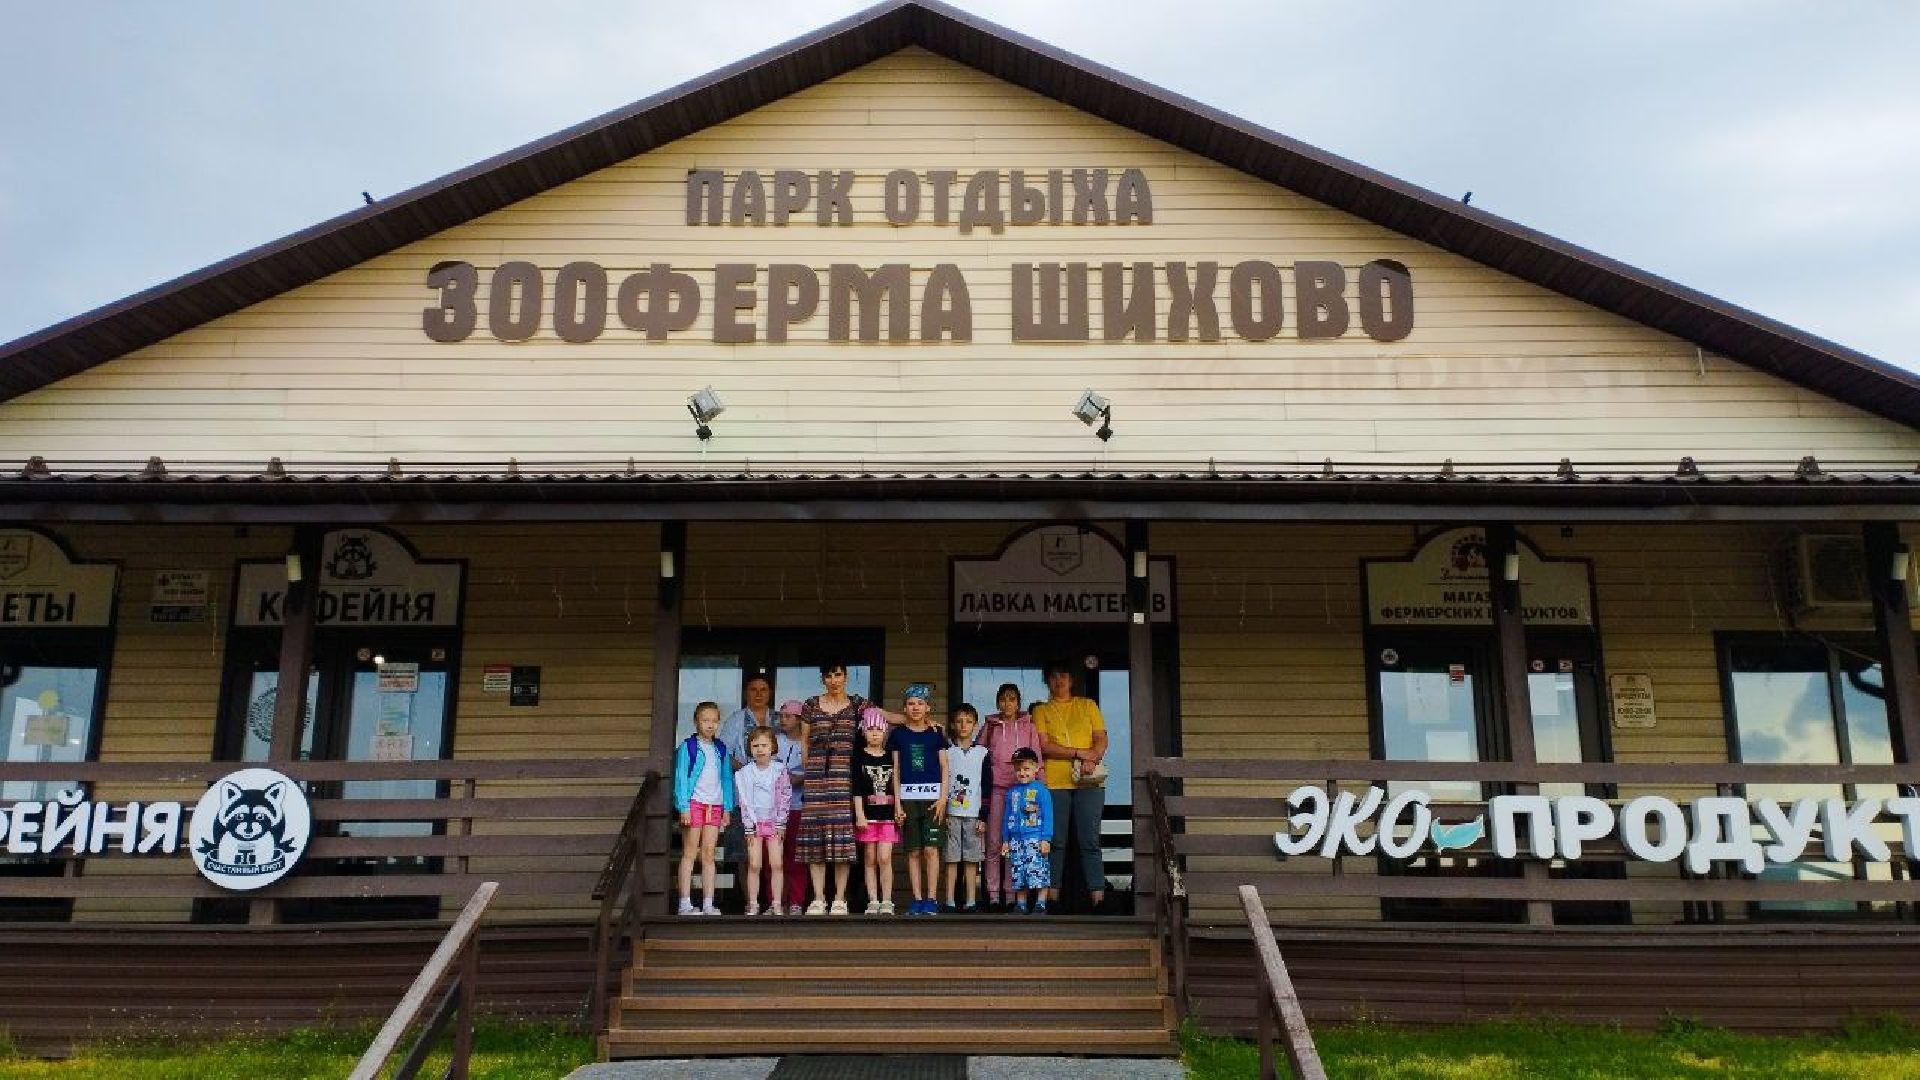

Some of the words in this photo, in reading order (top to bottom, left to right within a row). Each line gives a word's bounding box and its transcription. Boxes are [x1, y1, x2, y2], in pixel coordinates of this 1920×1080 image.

[686, 169, 855, 227] ПАРК
[885, 168, 1153, 235] ОТДЫХА
[422, 260, 974, 344] ЗООФЕРМА
[1011, 258, 1415, 344] ШИХОВО
[959, 592, 1036, 614] ЛАВКА
[1380, 606, 1484, 620] ФЕРМЕРСКИХ
[1487, 606, 1578, 621] ПДУКТОВ
[1274, 785, 1432, 860] ЭКО
